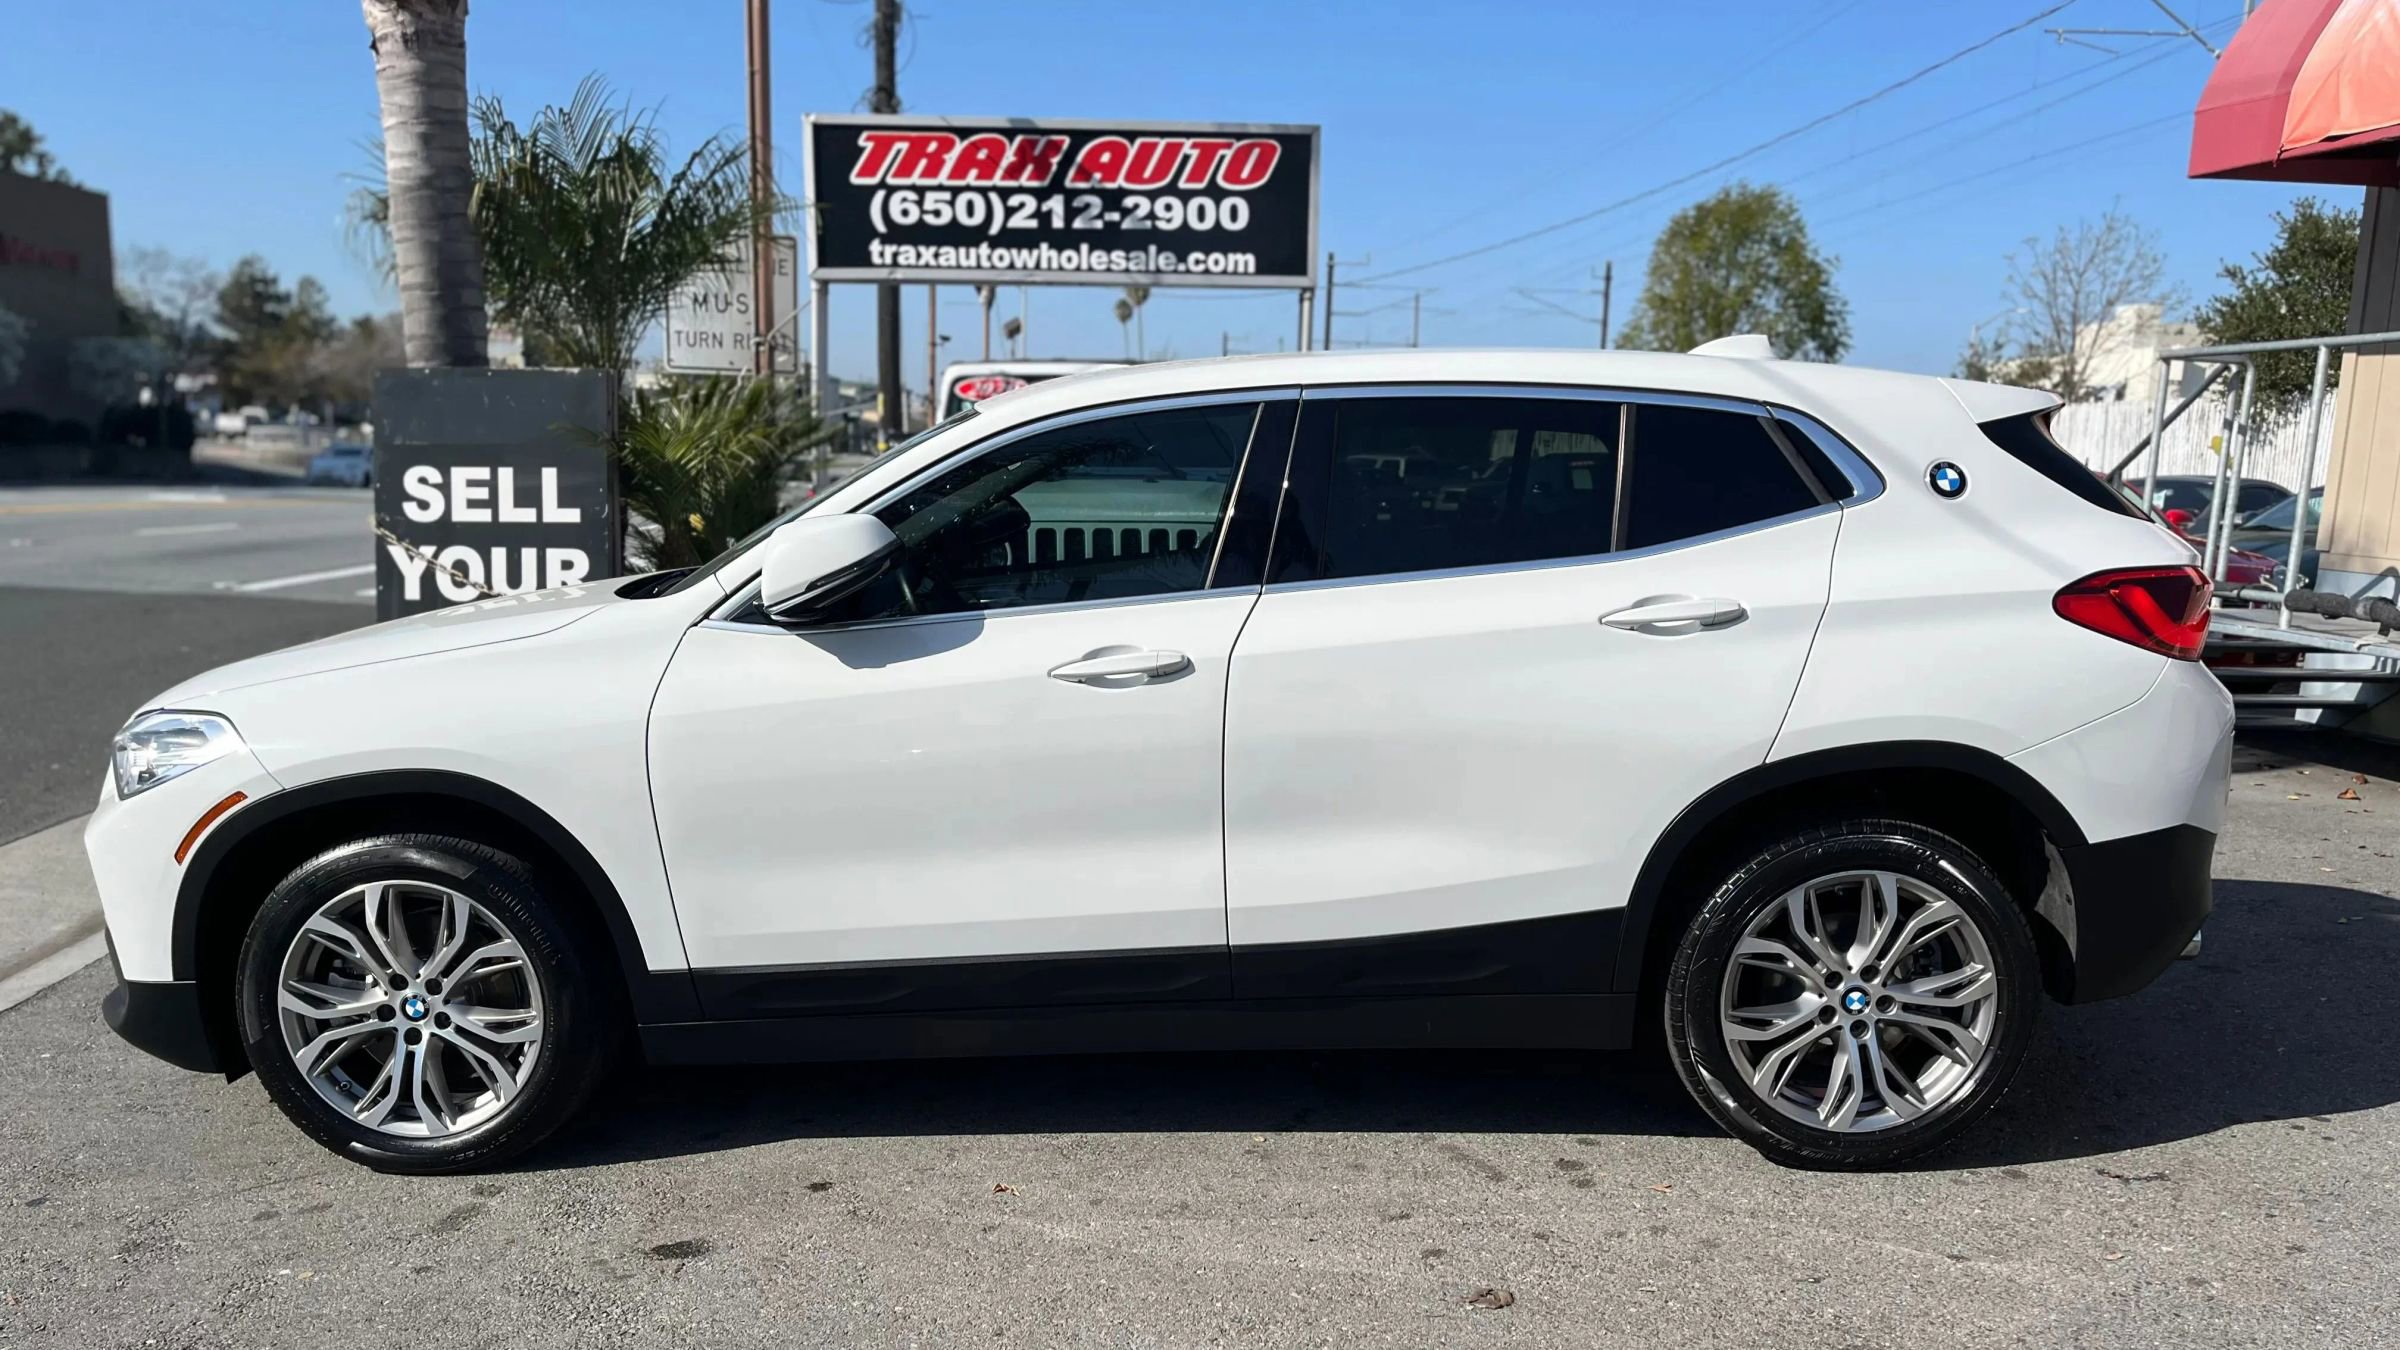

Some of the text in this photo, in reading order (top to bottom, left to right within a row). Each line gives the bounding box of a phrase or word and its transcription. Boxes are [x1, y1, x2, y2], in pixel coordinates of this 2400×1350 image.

[850, 131, 1281, 190] TRAX AUTO
[869, 190, 1250, 235] (650)212-2900
[869, 238, 1256, 274] traxautowholesale.com
[693, 292, 750, 314] MUS
[674, 329, 723, 349] TURN
[402, 464, 581, 523] SELL
[387, 545, 590, 602] YOUR
